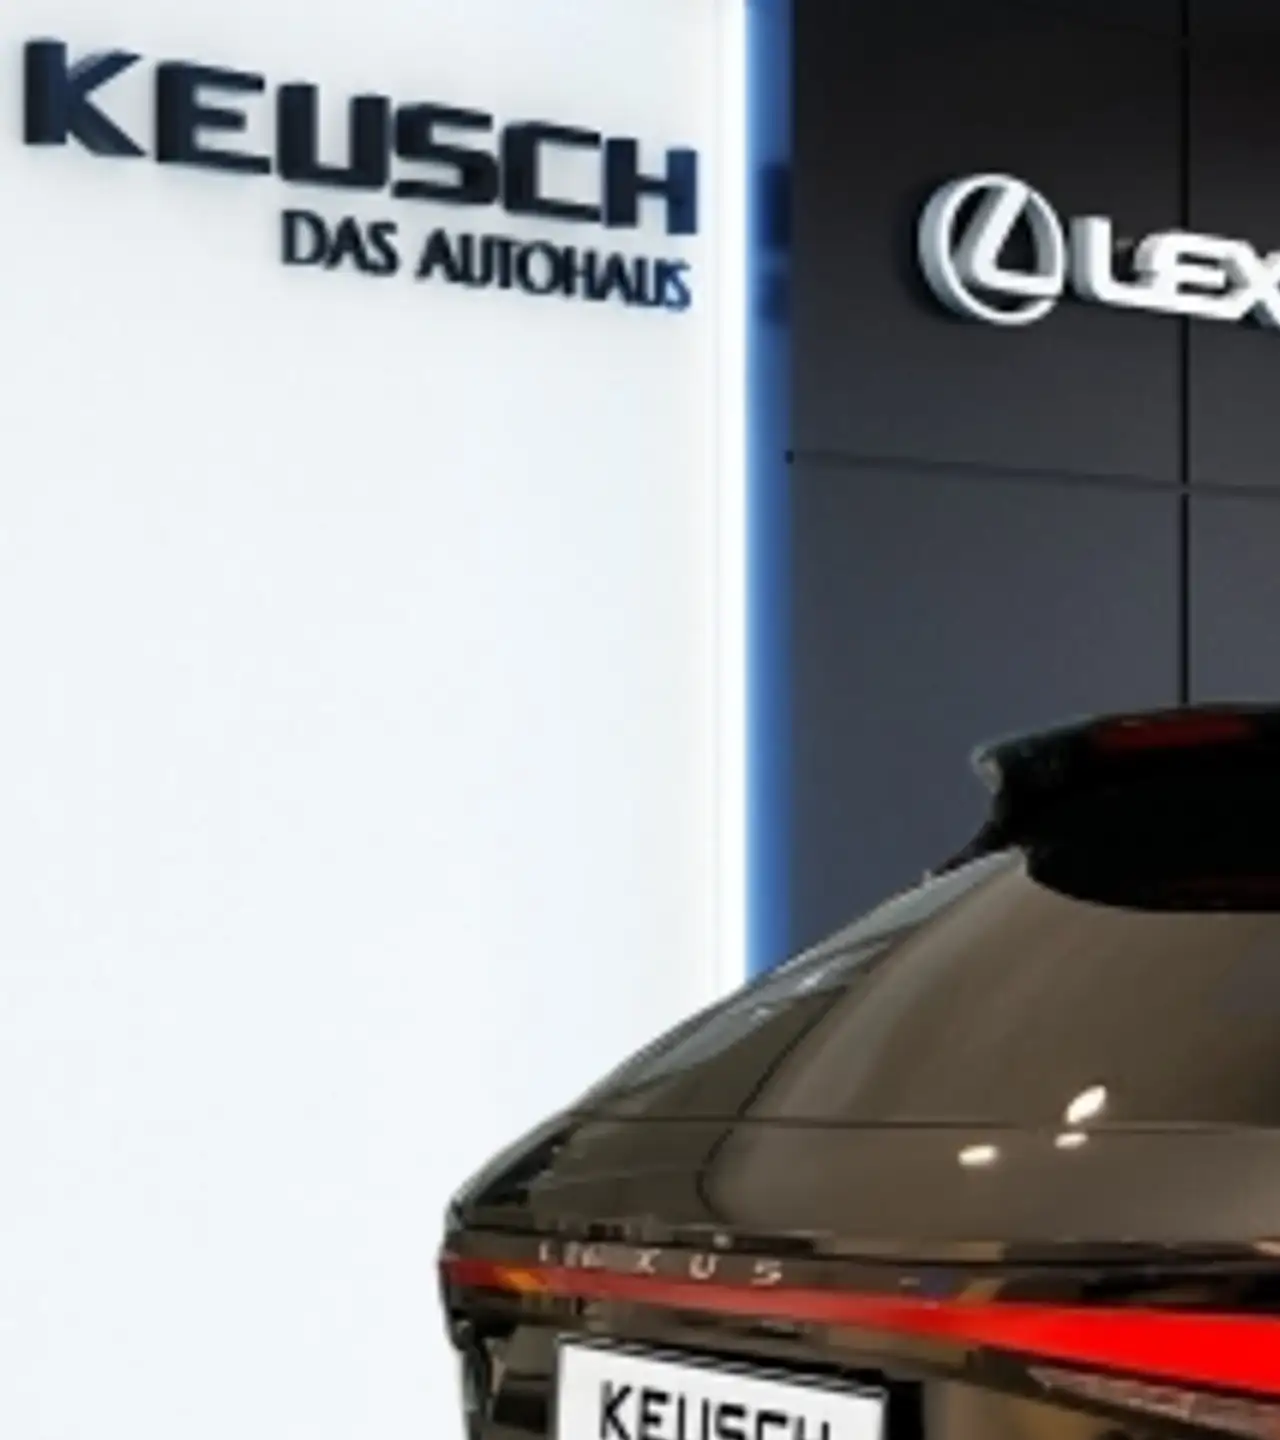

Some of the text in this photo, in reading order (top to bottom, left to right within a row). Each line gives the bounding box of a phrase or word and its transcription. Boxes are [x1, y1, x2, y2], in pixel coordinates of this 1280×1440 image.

[23, 38, 699, 236] KEUSCH
[281, 209, 692, 311] DAS AUTOHAUS
